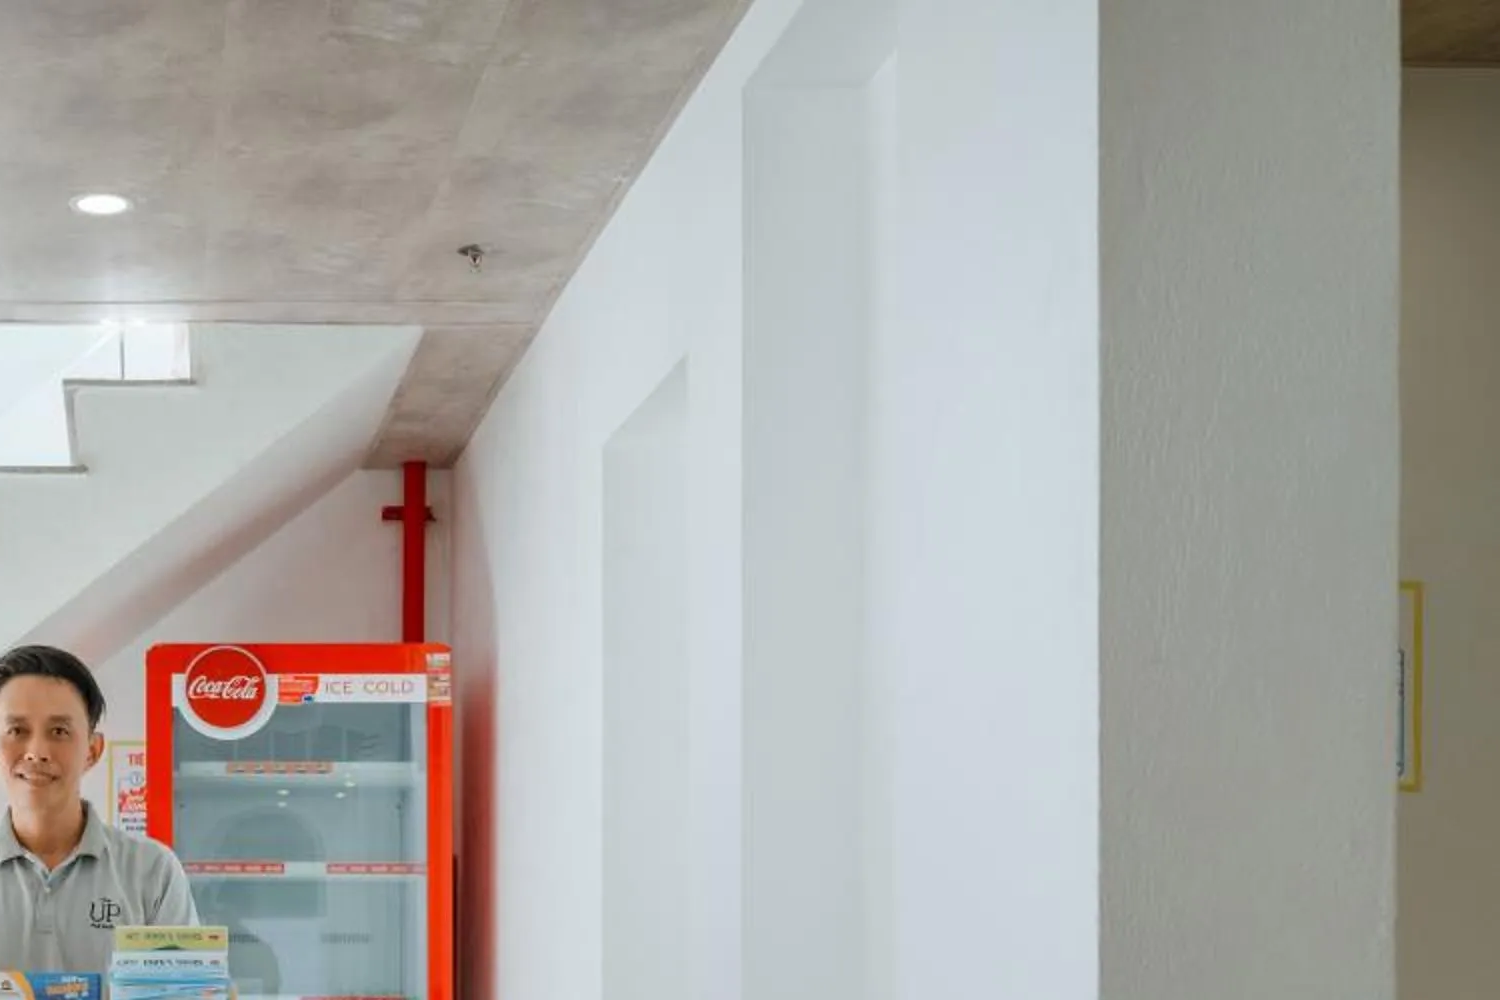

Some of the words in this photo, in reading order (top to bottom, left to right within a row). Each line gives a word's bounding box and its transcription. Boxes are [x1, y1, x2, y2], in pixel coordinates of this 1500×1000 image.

[188, 675, 260, 699] Coca-Cola
[325, 681, 354, 695] ICE
[363, 680, 415, 695] COLD
